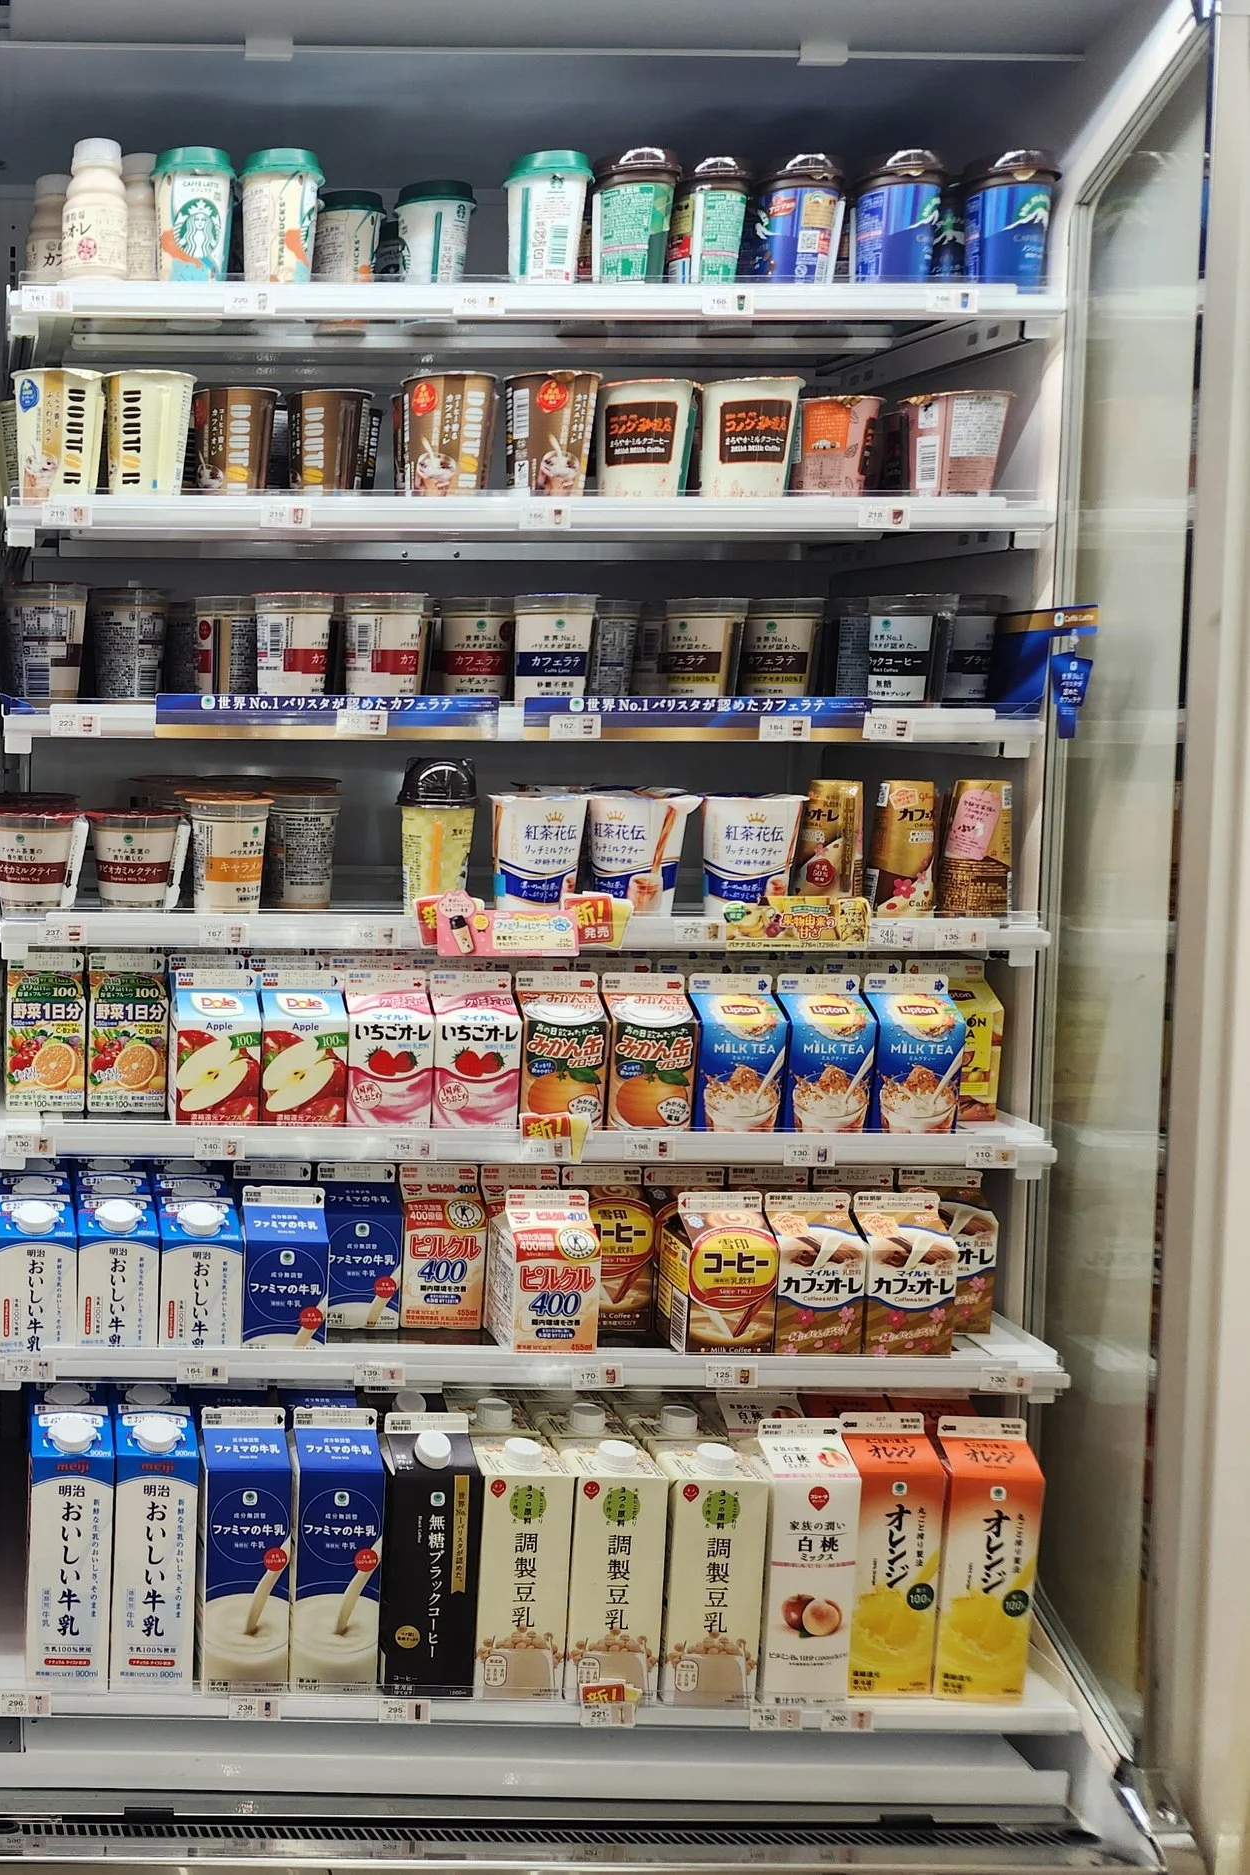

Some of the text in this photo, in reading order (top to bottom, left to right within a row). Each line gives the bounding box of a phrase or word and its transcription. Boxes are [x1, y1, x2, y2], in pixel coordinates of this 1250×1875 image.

[454, 652, 503, 669] カフェラテ
[531, 653, 582, 669] カフェラテ
[875, 678, 893, 690] 無糖
[217, 696, 246, 711] 世界
[249, 696, 279, 711] No.1
[586, 698, 615, 712] 世界
[618, 698, 649, 712] No.1
[524, 824, 579, 842] 紅茶花伝
[592, 823, 648, 842] 紅茶花伝
[724, 824, 785, 843] 紅茶花伝
[584, 926, 610, 939] 発売
[10, 1002, 85, 1022] 野菜1日分
[93, 1002, 169, 1022] 野菜1日分
[201, 996, 237, 1010] Dole
[287, 997, 322, 1011] Dole
[725, 1004, 760, 1017] Lipton
[813, 1004, 850, 1017] Lipton
[901, 1004, 937, 1017] Lipton
[206, 1020, 234, 1034] Apple
[291, 1020, 320, 1034] Apple
[355, 1023, 432, 1043] いちごオーレ
[441, 1023, 519, 1043] いちごオーレ
[526, 1035, 603, 1058] みかん缶
[614, 1037, 693, 1059] みかん缶
[714, 1041, 777, 1055] MILK TEA
[802, 1041, 865, 1055] MILK TEA
[890, 1041, 954, 1055] MILK TEA
[252, 1219, 317, 1232] ファミマの牛乳
[26, 1248, 46, 1259] 明治
[109, 1247, 129, 1258] 明治
[409, 1233, 481, 1261] ピルクル
[703, 1251, 771, 1273] コーヒー
[417, 1260, 469, 1286] 400
[517, 1264, 597, 1294] ピルクル
[249, 1282, 322, 1299] ファミマの牛乳
[782, 1275, 862, 1297] カフェオーレ
[873, 1275, 955, 1298] カフェオーレ
[528, 1291, 581, 1317] 400
[57, 1484, 87, 1498] 明治
[142, 1484, 171, 1498] 明治
[212, 1523, 286, 1538] ファミマの牛乳
[303, 1523, 378, 1538] ファミマの牛乳
[797, 1535, 840, 1553] 白桃
[884, 1503, 912, 1589] オレンジ
[981, 1509, 1011, 1594] オレンジ
[56, 1500, 83, 1638] おいしい牛乳
[140, 1500, 168, 1638] おいしい牛乳
[426, 1514, 447, 1659] 無糖ブラックコーヒー
[511, 1531, 539, 1629] 調製豆乳
[604, 1534, 633, 1632] 調製豆乳
[702, 1536, 732, 1634] 調製豆乳
